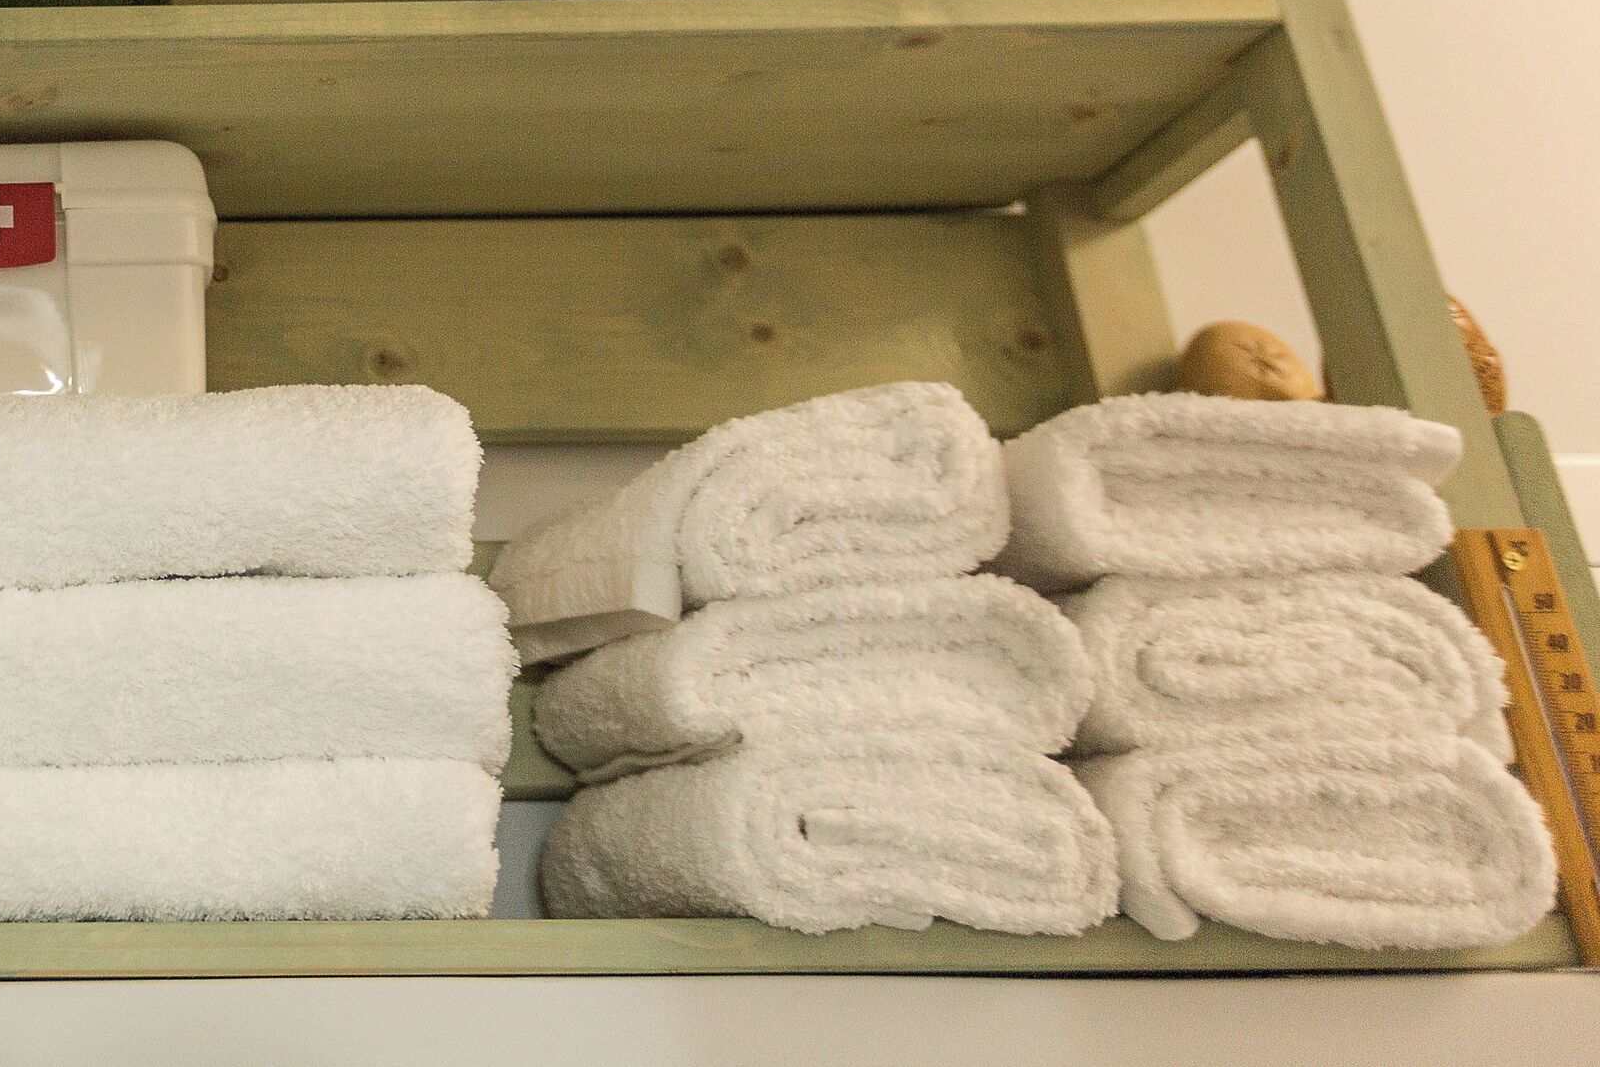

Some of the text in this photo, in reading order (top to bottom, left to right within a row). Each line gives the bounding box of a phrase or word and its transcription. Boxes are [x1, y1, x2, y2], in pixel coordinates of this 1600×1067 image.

[1533, 593, 1554, 610] 50
[1547, 633, 1569, 652] 40
[1560, 673, 1582, 691] 30
[1575, 712, 1596, 731] 20
